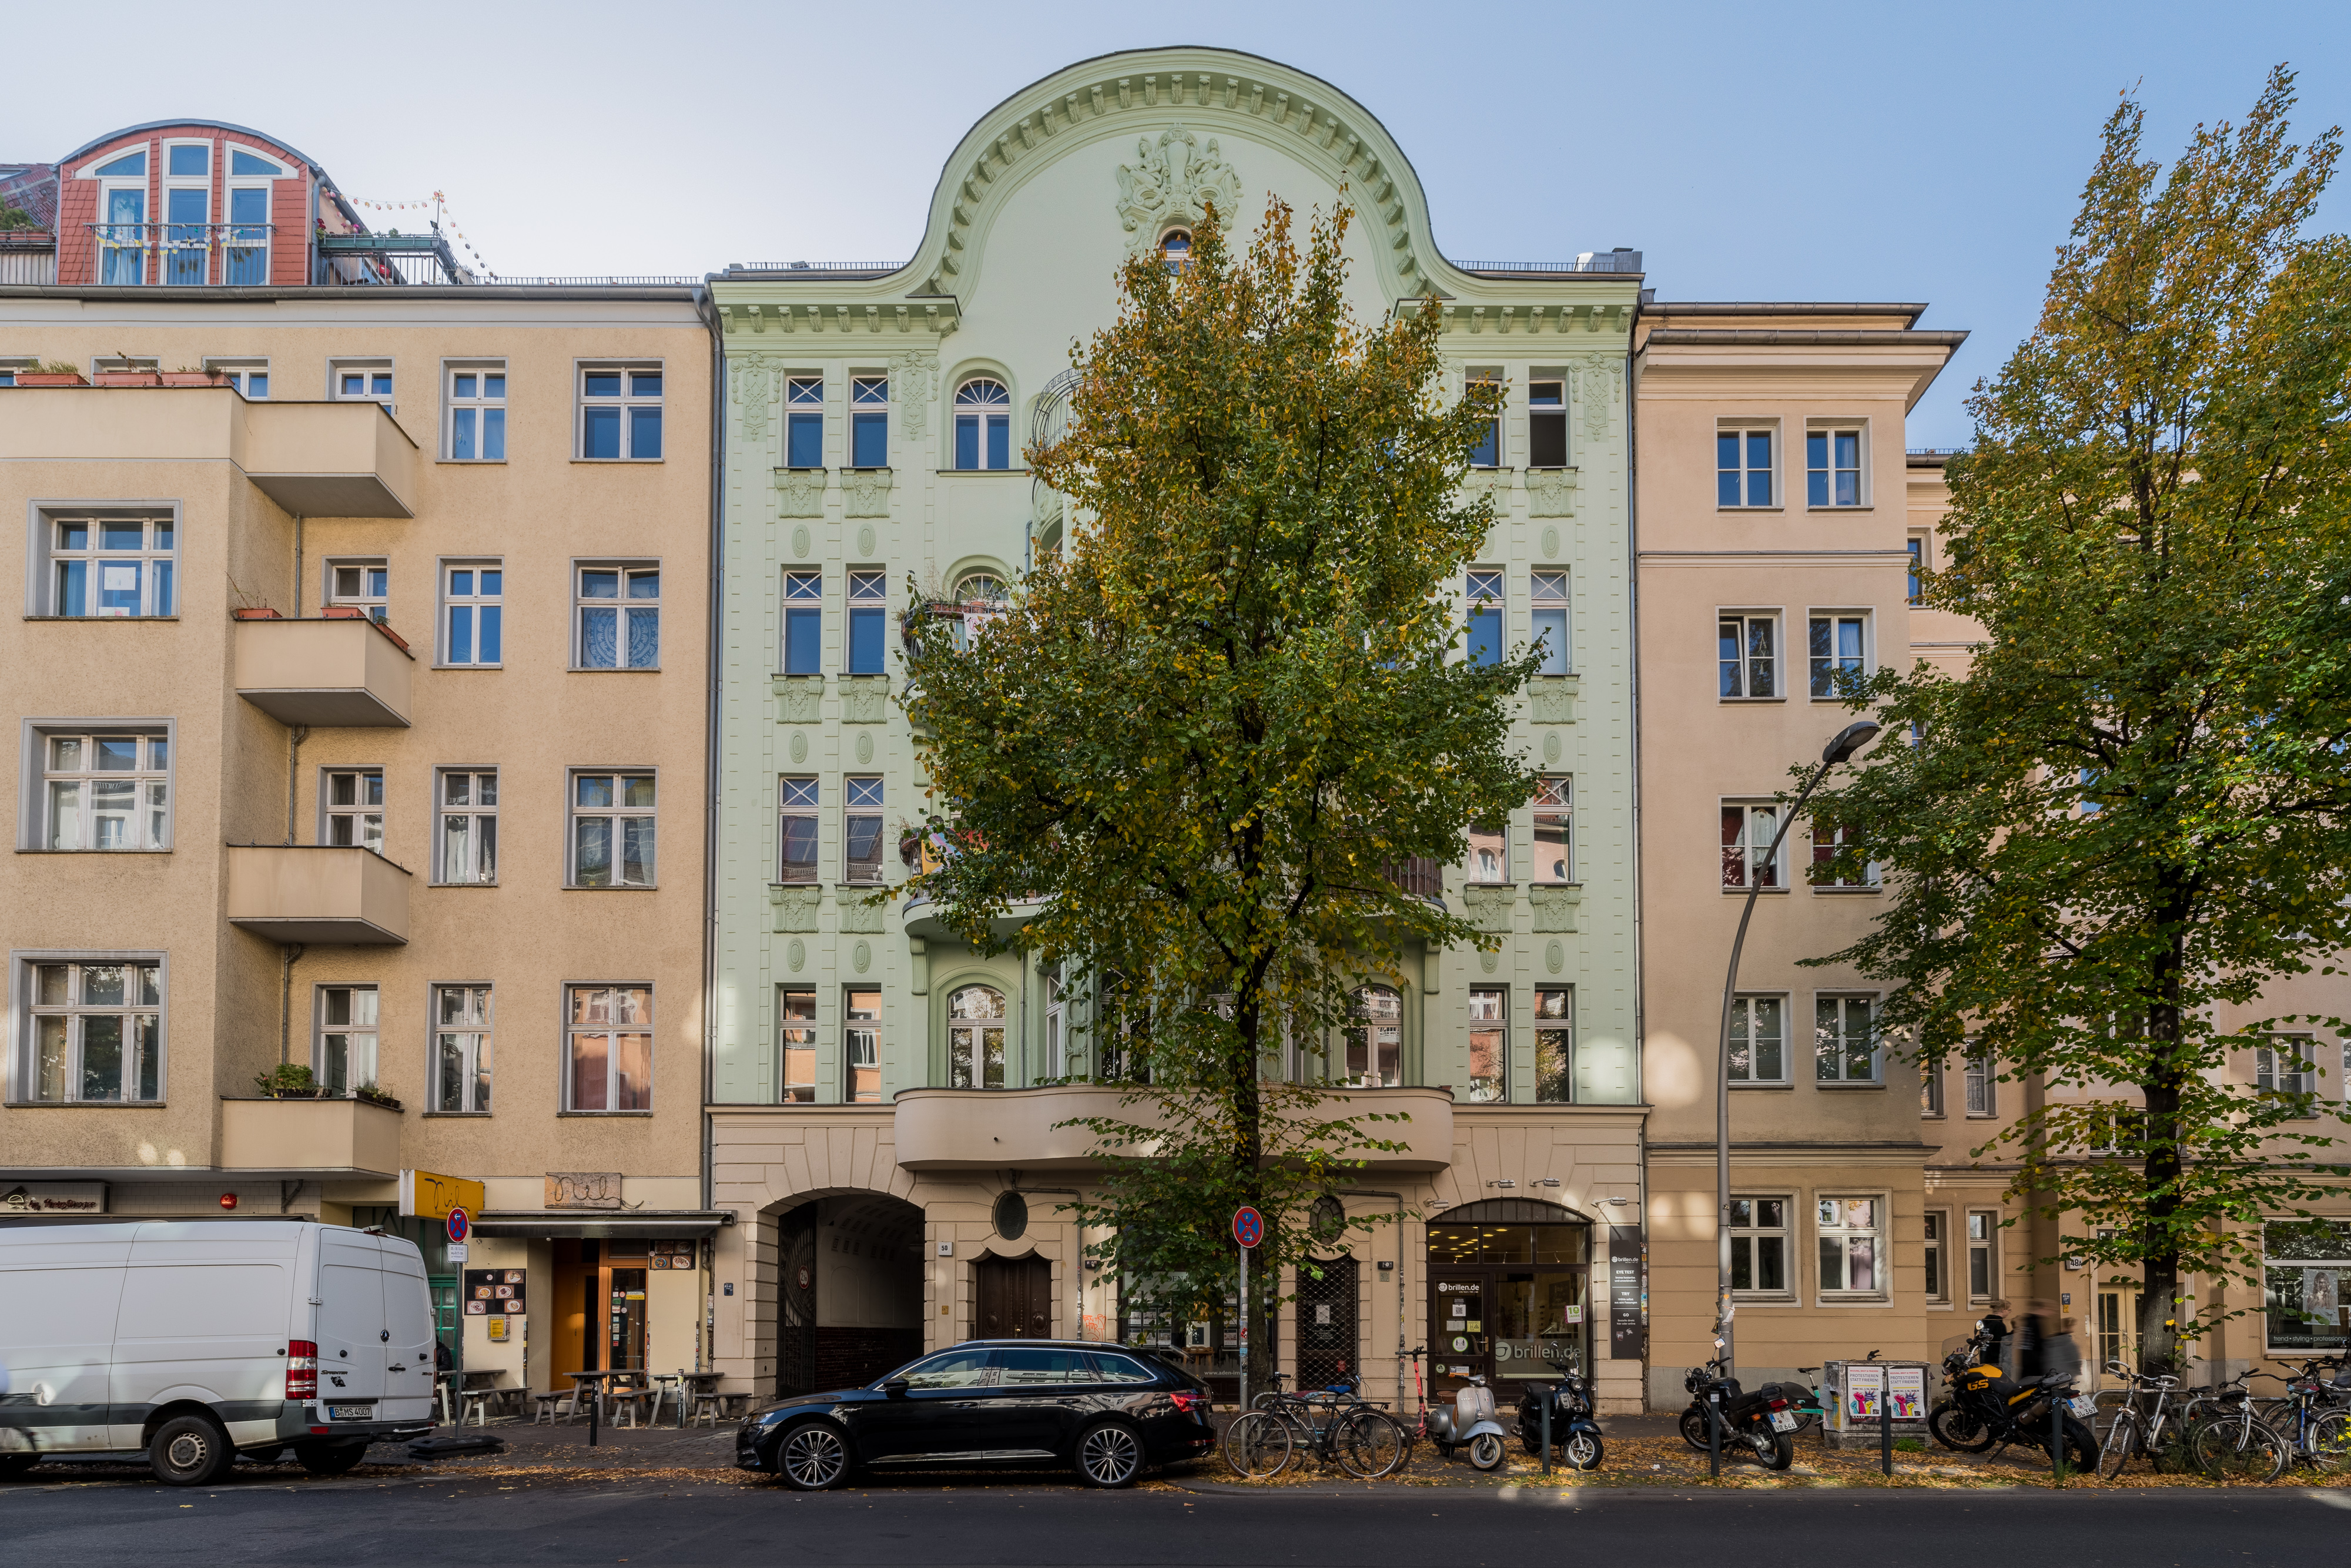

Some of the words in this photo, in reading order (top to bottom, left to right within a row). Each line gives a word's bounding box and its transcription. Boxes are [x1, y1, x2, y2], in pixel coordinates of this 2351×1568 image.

[1514, 1345, 1582, 1358] brillen.de
[1967, 1379, 1989, 1391] GS
[2084, 1406, 2096, 1415] 367
